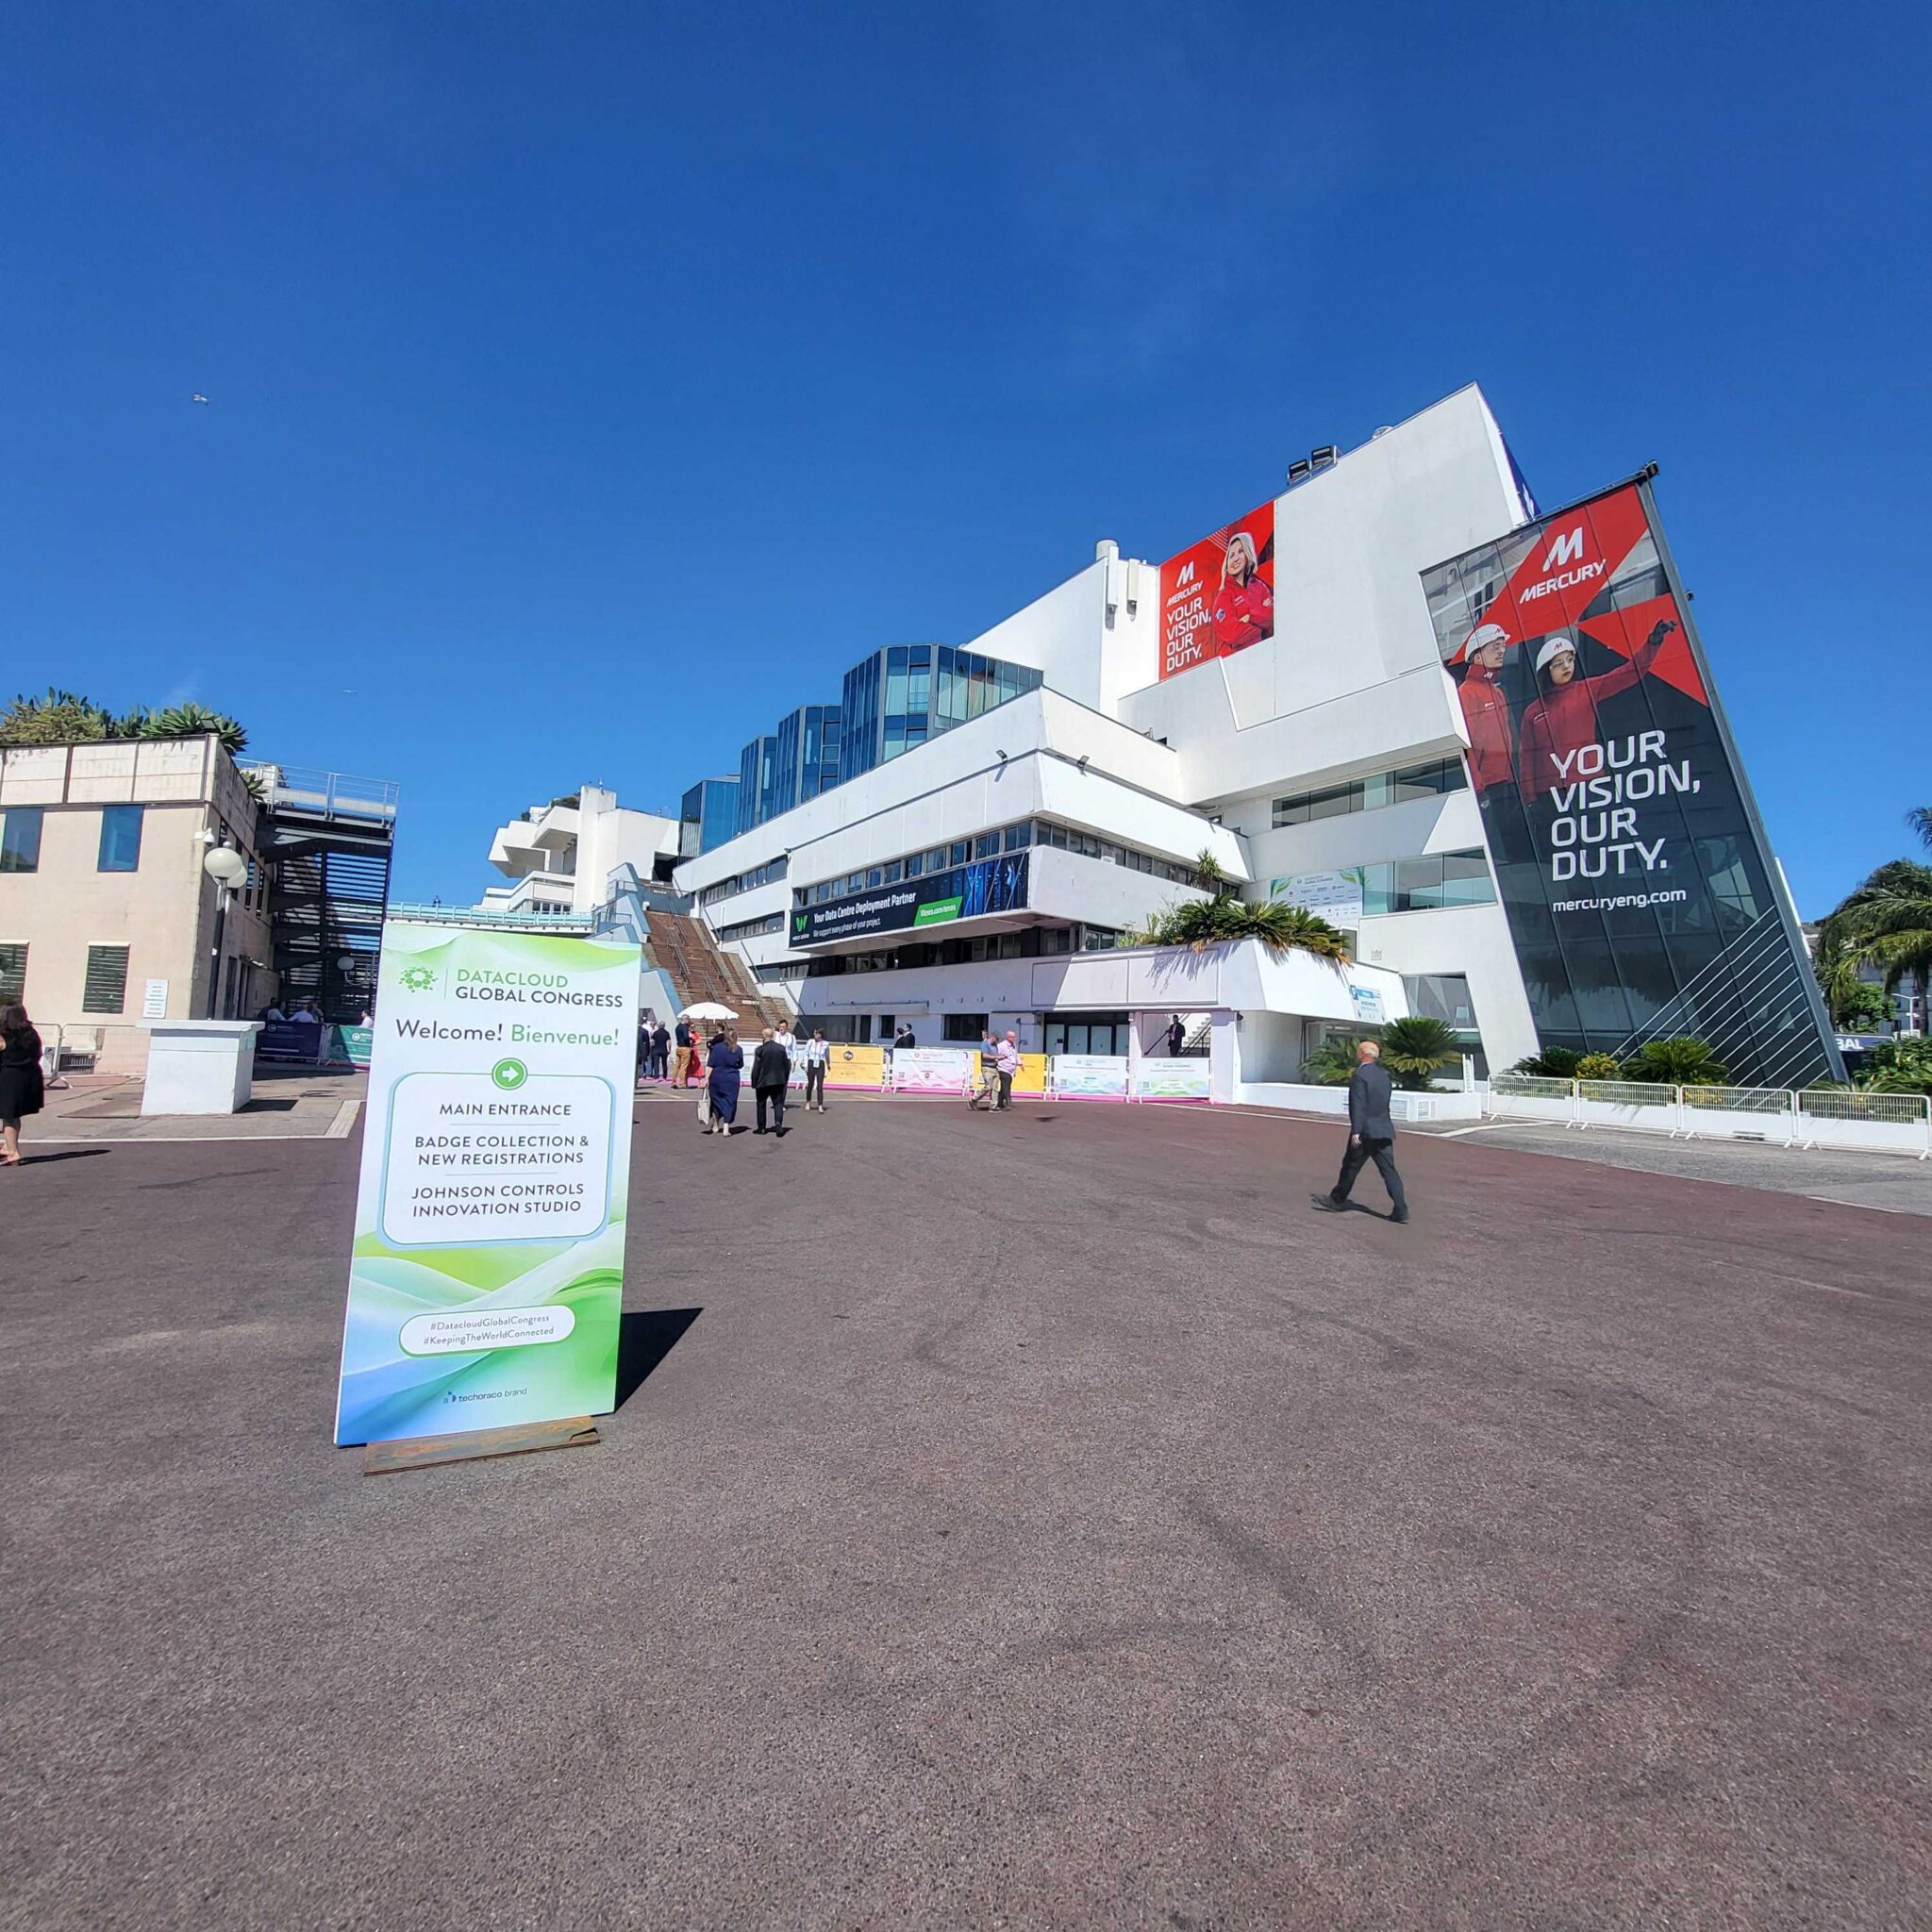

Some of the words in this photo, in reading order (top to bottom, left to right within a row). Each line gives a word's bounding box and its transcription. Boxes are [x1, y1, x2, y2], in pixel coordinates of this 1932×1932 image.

[1166, 580, 1203, 607] MERCURY
[1519, 558, 1606, 604] MERCURY
[1166, 597, 1202, 625] YOUR
[1166, 608, 1211, 641] VISION,
[1166, 633, 1193, 656] OUR
[1166, 644, 1202, 672] DUTY.
[1549, 729, 1667, 779] YOUR
[1549, 760, 1701, 813] VISION,
[1551, 807, 1638, 848] OUR
[1552, 838, 1668, 882] DUTY.
[814, 913, 824, 924] Your
[825, 909, 837, 922] Data
[838, 906, 855, 918] Centre
[856, 897, 891, 915] Deployment
[891, 892, 916, 907] Partner
[1552, 888, 1687, 913] mercuryeng.com
[457, 969, 568, 988] DATACLOUD
[456, 986, 526, 1002] GLOBAL
[531, 991, 623, 1008] CONGRESS
[395, 1018, 503, 1041] Welcome!
[511, 1024, 619, 1045] Bienvenue!
[440, 1104, 483, 1115] MAIN
[489, 1104, 572, 1116] ENTRANCE
[415, 1136, 472, 1148] BADGE
[476, 1136, 575, 1147] COLLECTION
[579, 1136, 589, 1147] &
[418, 1154, 457, 1165] NEW
[461, 1152, 584, 1165] REGISTRATIONS
[411, 1186, 495, 1200] JOHNSON
[500, 1183, 584, 1197] CONTROLS
[413, 1203, 519, 1217] INNOVATION
[525, 1200, 581, 1213] STUDIO
[430, 1315, 550, 1331] #DatacloudGlobalCongress
[424, 1326, 554, 1346] #KeepingTheWorldConnected
[504, 1388, 527, 1397] brand
